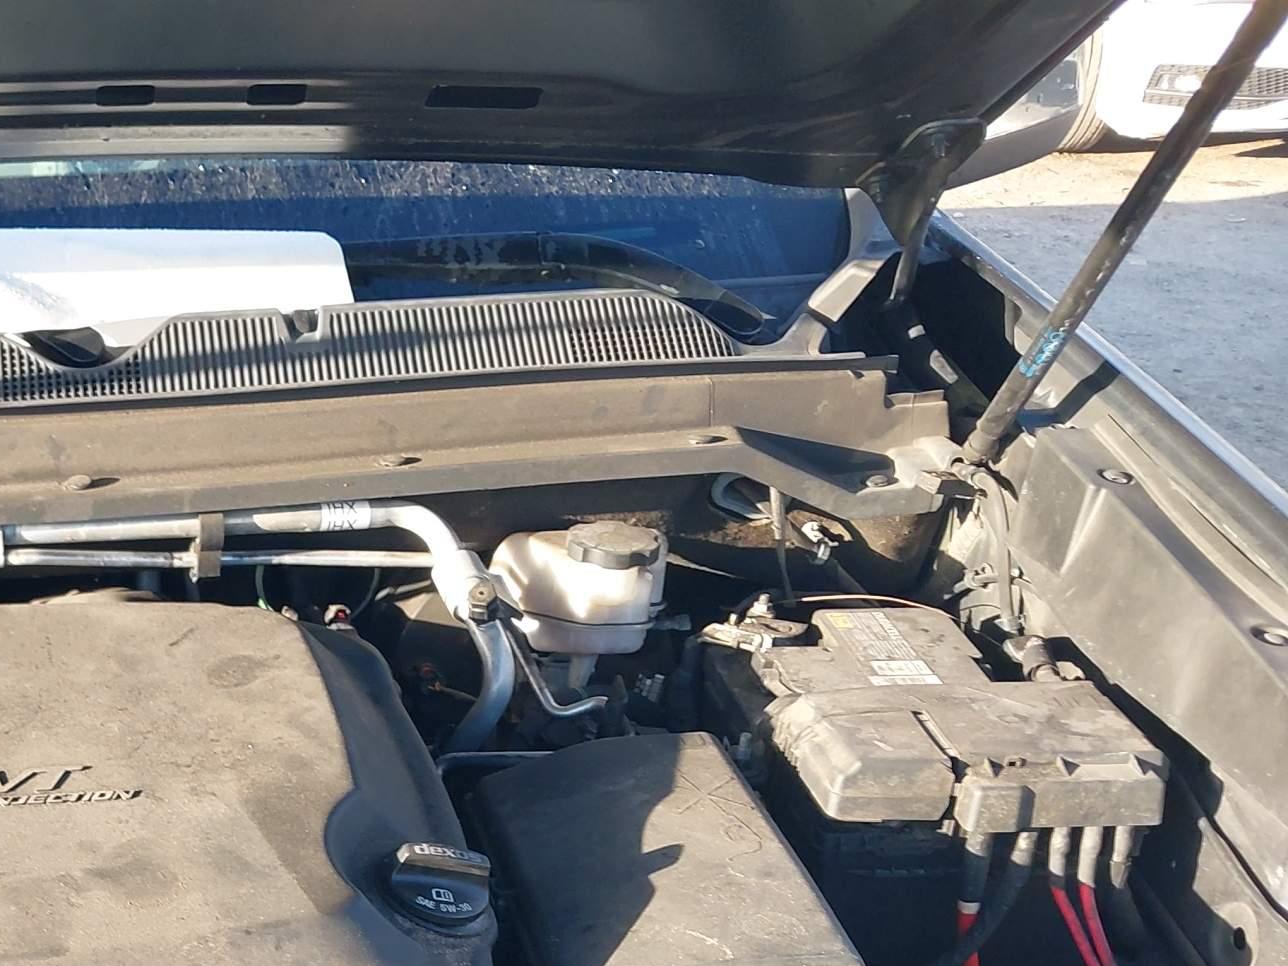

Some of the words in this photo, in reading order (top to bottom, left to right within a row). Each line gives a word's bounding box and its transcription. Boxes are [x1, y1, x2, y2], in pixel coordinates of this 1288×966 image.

[413, 843, 483, 863] dexos
[415, 895, 437, 910] SAE
[439, 902, 472, 913] 5W-30
